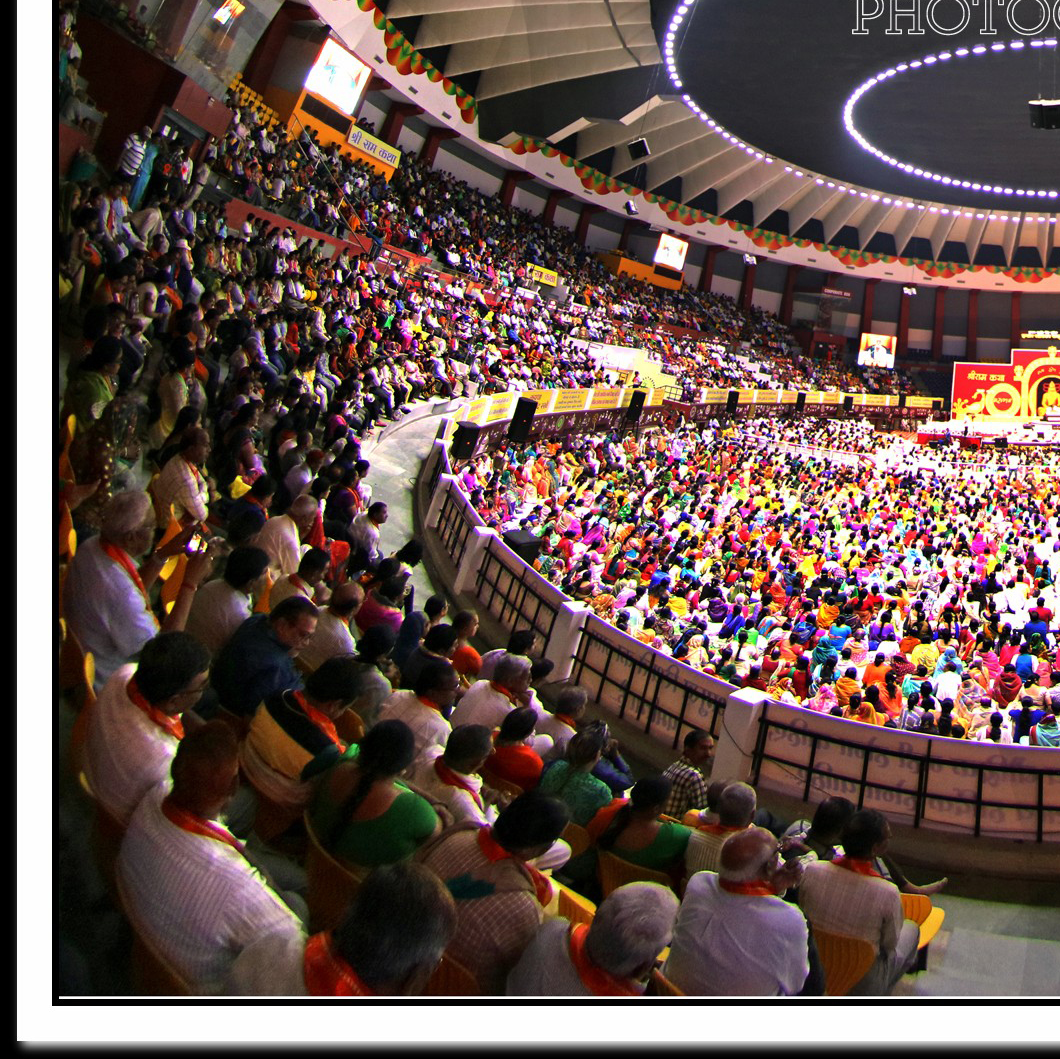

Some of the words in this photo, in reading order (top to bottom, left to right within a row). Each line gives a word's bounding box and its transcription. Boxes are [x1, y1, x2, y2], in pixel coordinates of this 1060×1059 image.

[352, 131, 362, 144] श्री
[363, 139, 377, 153] राम
[379, 148, 397, 164] कथा
